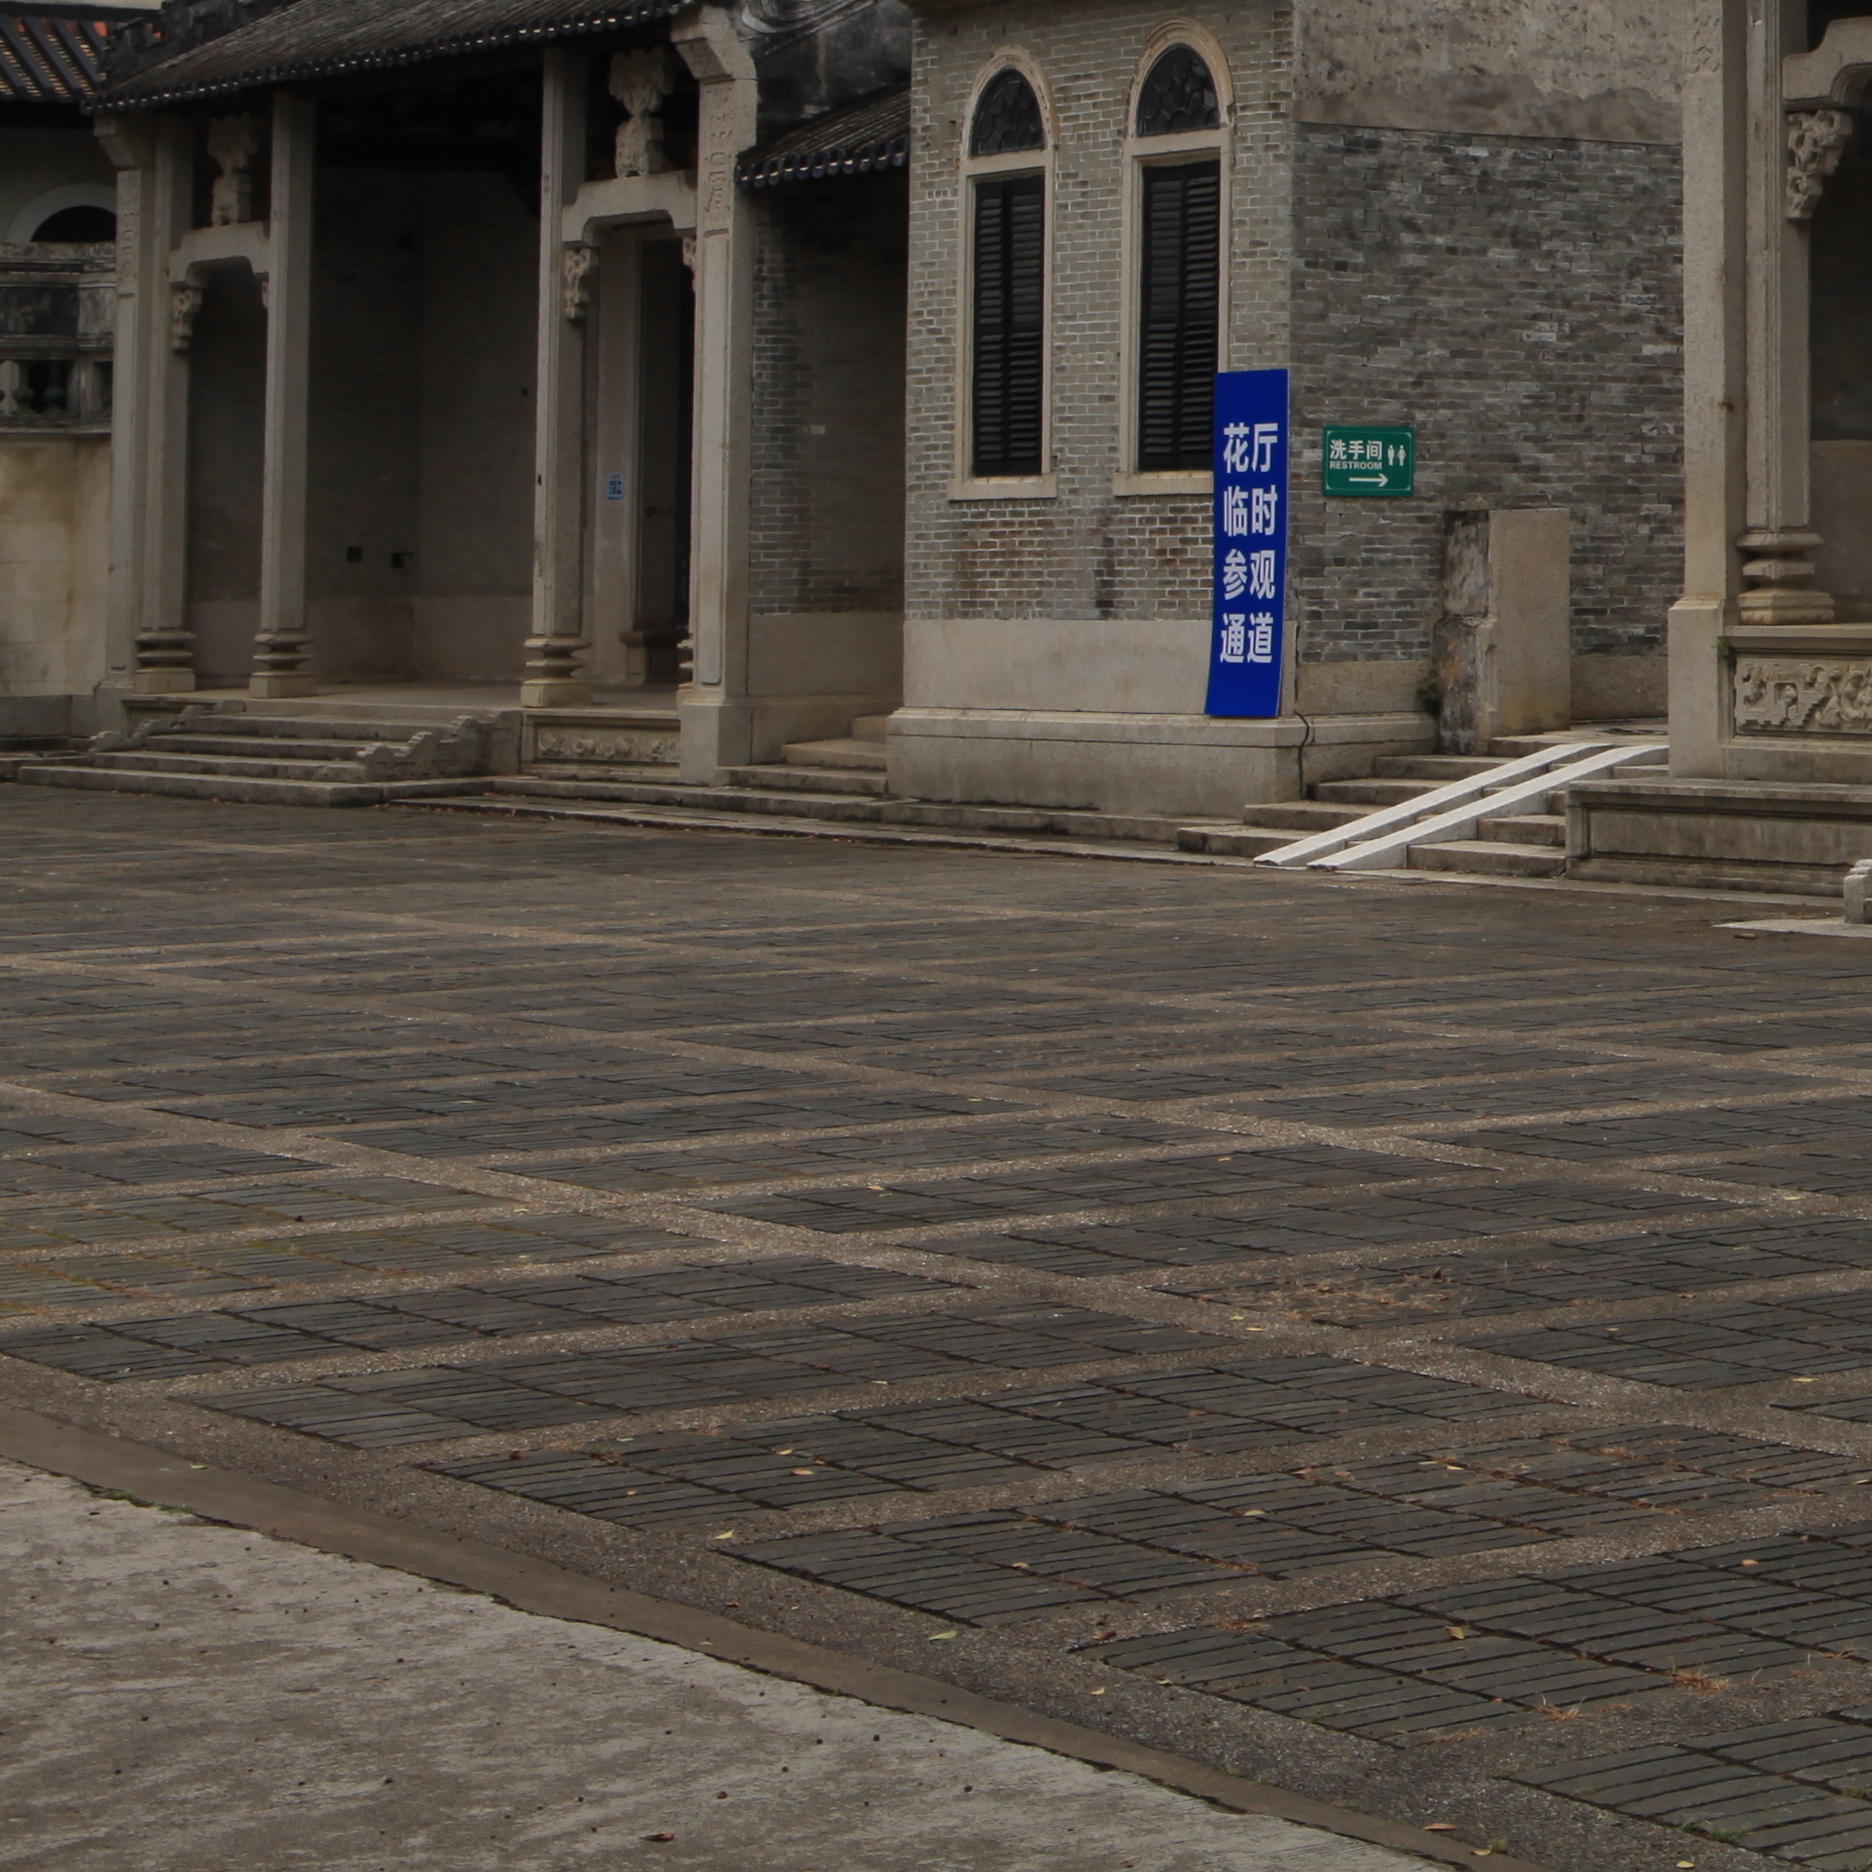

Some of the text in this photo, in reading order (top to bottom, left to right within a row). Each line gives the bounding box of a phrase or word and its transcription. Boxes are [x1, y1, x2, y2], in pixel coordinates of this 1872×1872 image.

[1223, 422, 1278, 473] 花厅
[1330, 439, 1383, 460] 洗手间
[1330, 461, 1383, 470] RESTROOM
[1223, 485, 1278, 537] 临时
[1222, 549, 1276, 601] 参观
[1220, 612, 1274, 664] 通道
